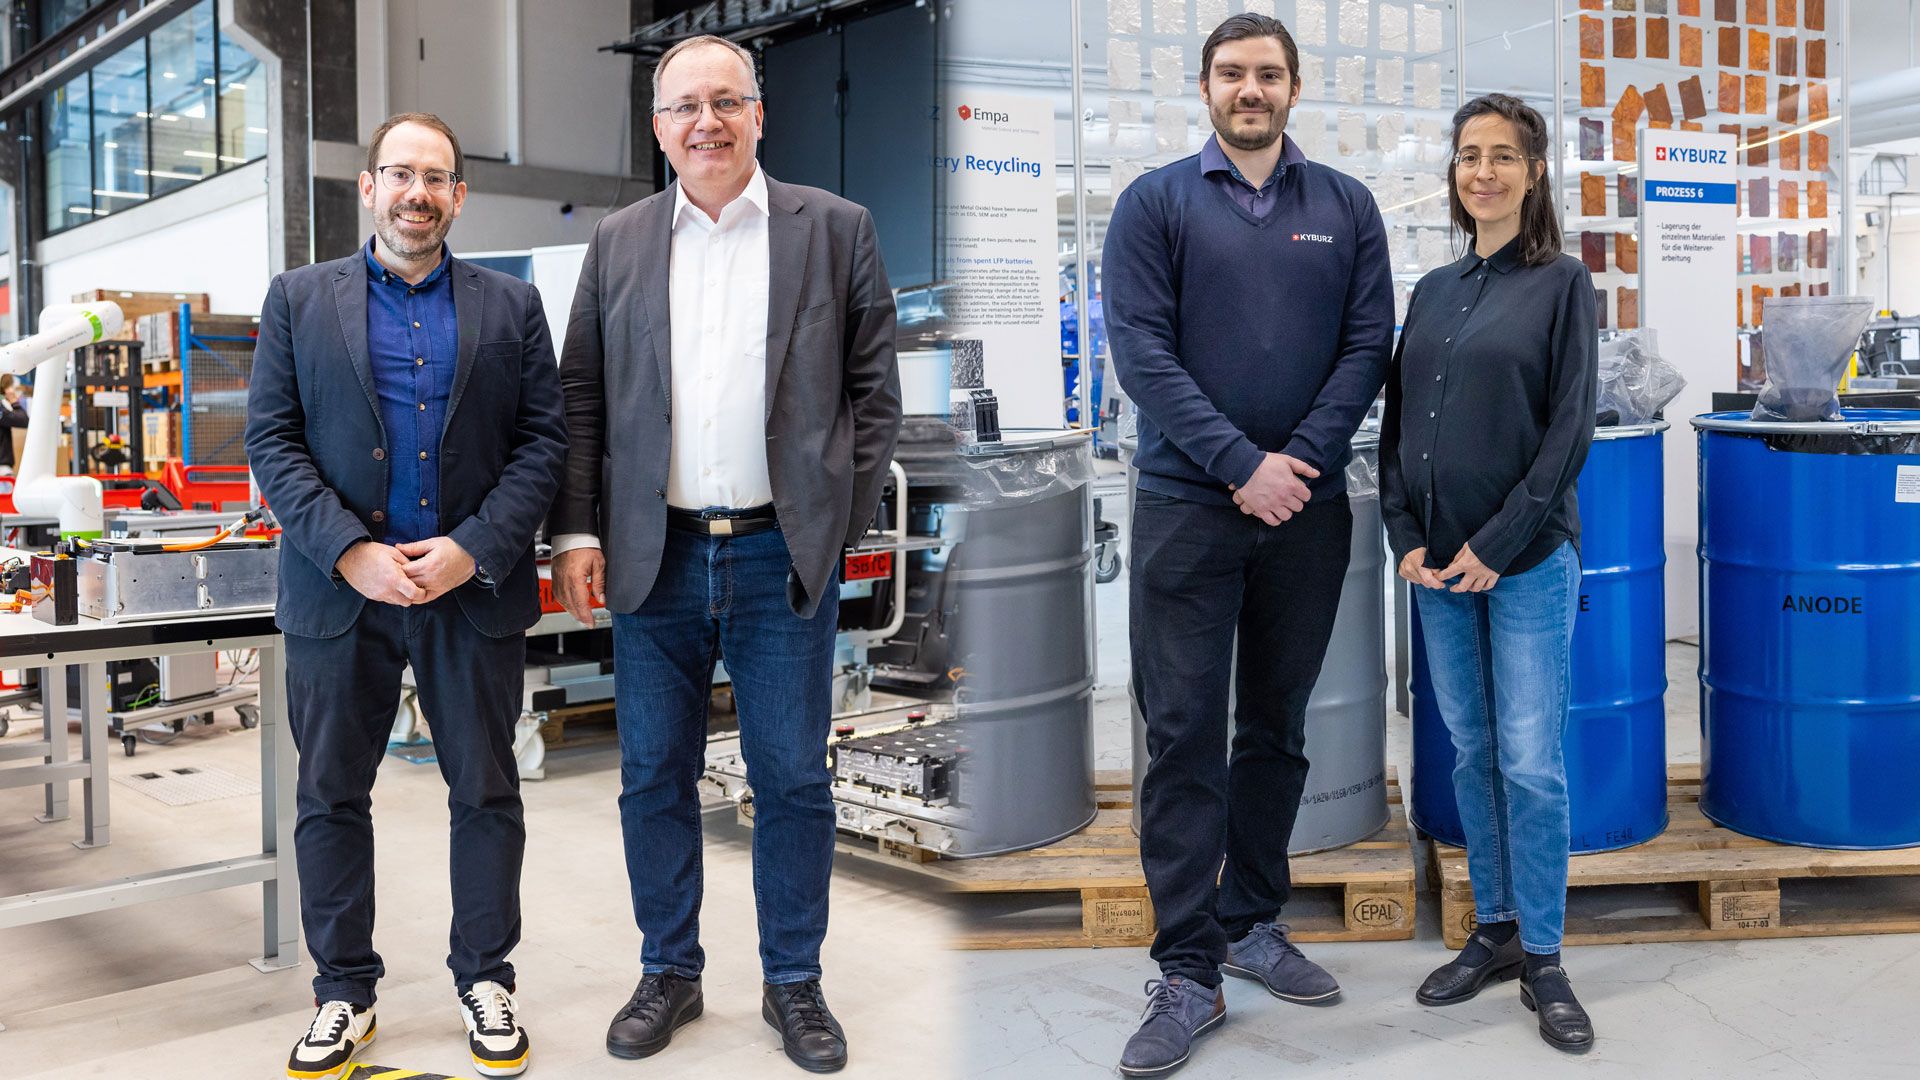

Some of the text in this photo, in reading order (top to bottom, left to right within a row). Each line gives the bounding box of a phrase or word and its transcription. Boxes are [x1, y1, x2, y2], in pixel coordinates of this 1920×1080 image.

[973, 107, 1009, 125] Empa
[1669, 147, 1727, 164] KYBURZ
[965, 155, 1041, 177] Recycling
[1656, 186, 1704, 198] PROZESS 6
[1661, 222, 1690, 232] Lagerung
[1300, 233, 1333, 243] KYBURZ
[1661, 254, 1691, 263] arbeitung
[1782, 595, 1862, 614] ANODE
[1361, 904, 1394, 921] EPAL
[1738, 920, 1769, 929] 104-7-03
